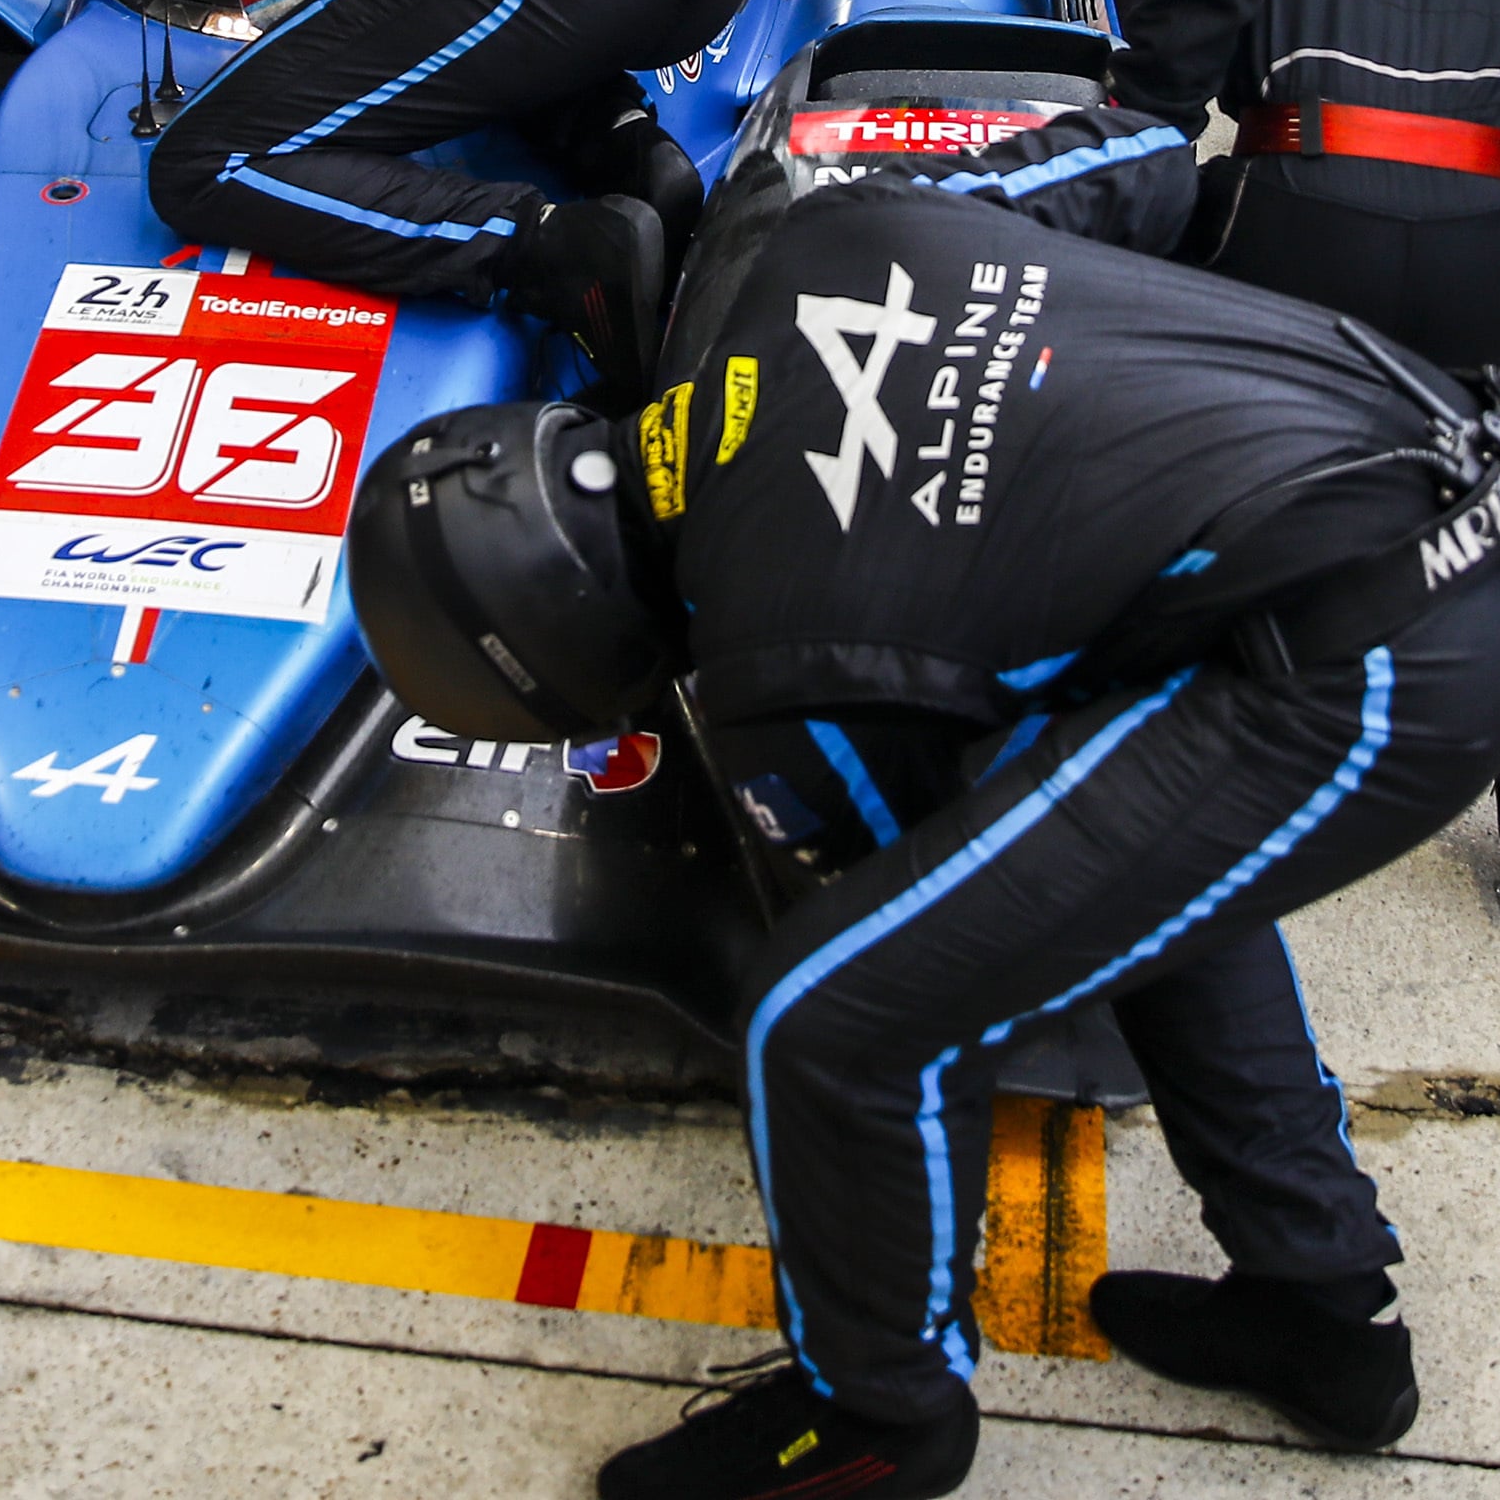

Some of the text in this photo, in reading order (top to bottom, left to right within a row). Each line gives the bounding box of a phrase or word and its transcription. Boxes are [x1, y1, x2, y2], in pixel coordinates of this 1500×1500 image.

[876, 111, 1010, 123] MAISON
[67, 305, 160, 320] LE MANS
[198, 295, 388, 328] TotalEnergies
[1008, 264, 1049, 326] TEAM
[910, 262, 1008, 527] ALPINE
[5, 351, 359, 510] 36
[955, 329, 1026, 526] ENDURANCE
[51, 533, 248, 572] WEC
[41, 578, 157, 595] CHAMPIONSHIP
[44, 568, 222, 591] FIA WORLD ENDURANCE
